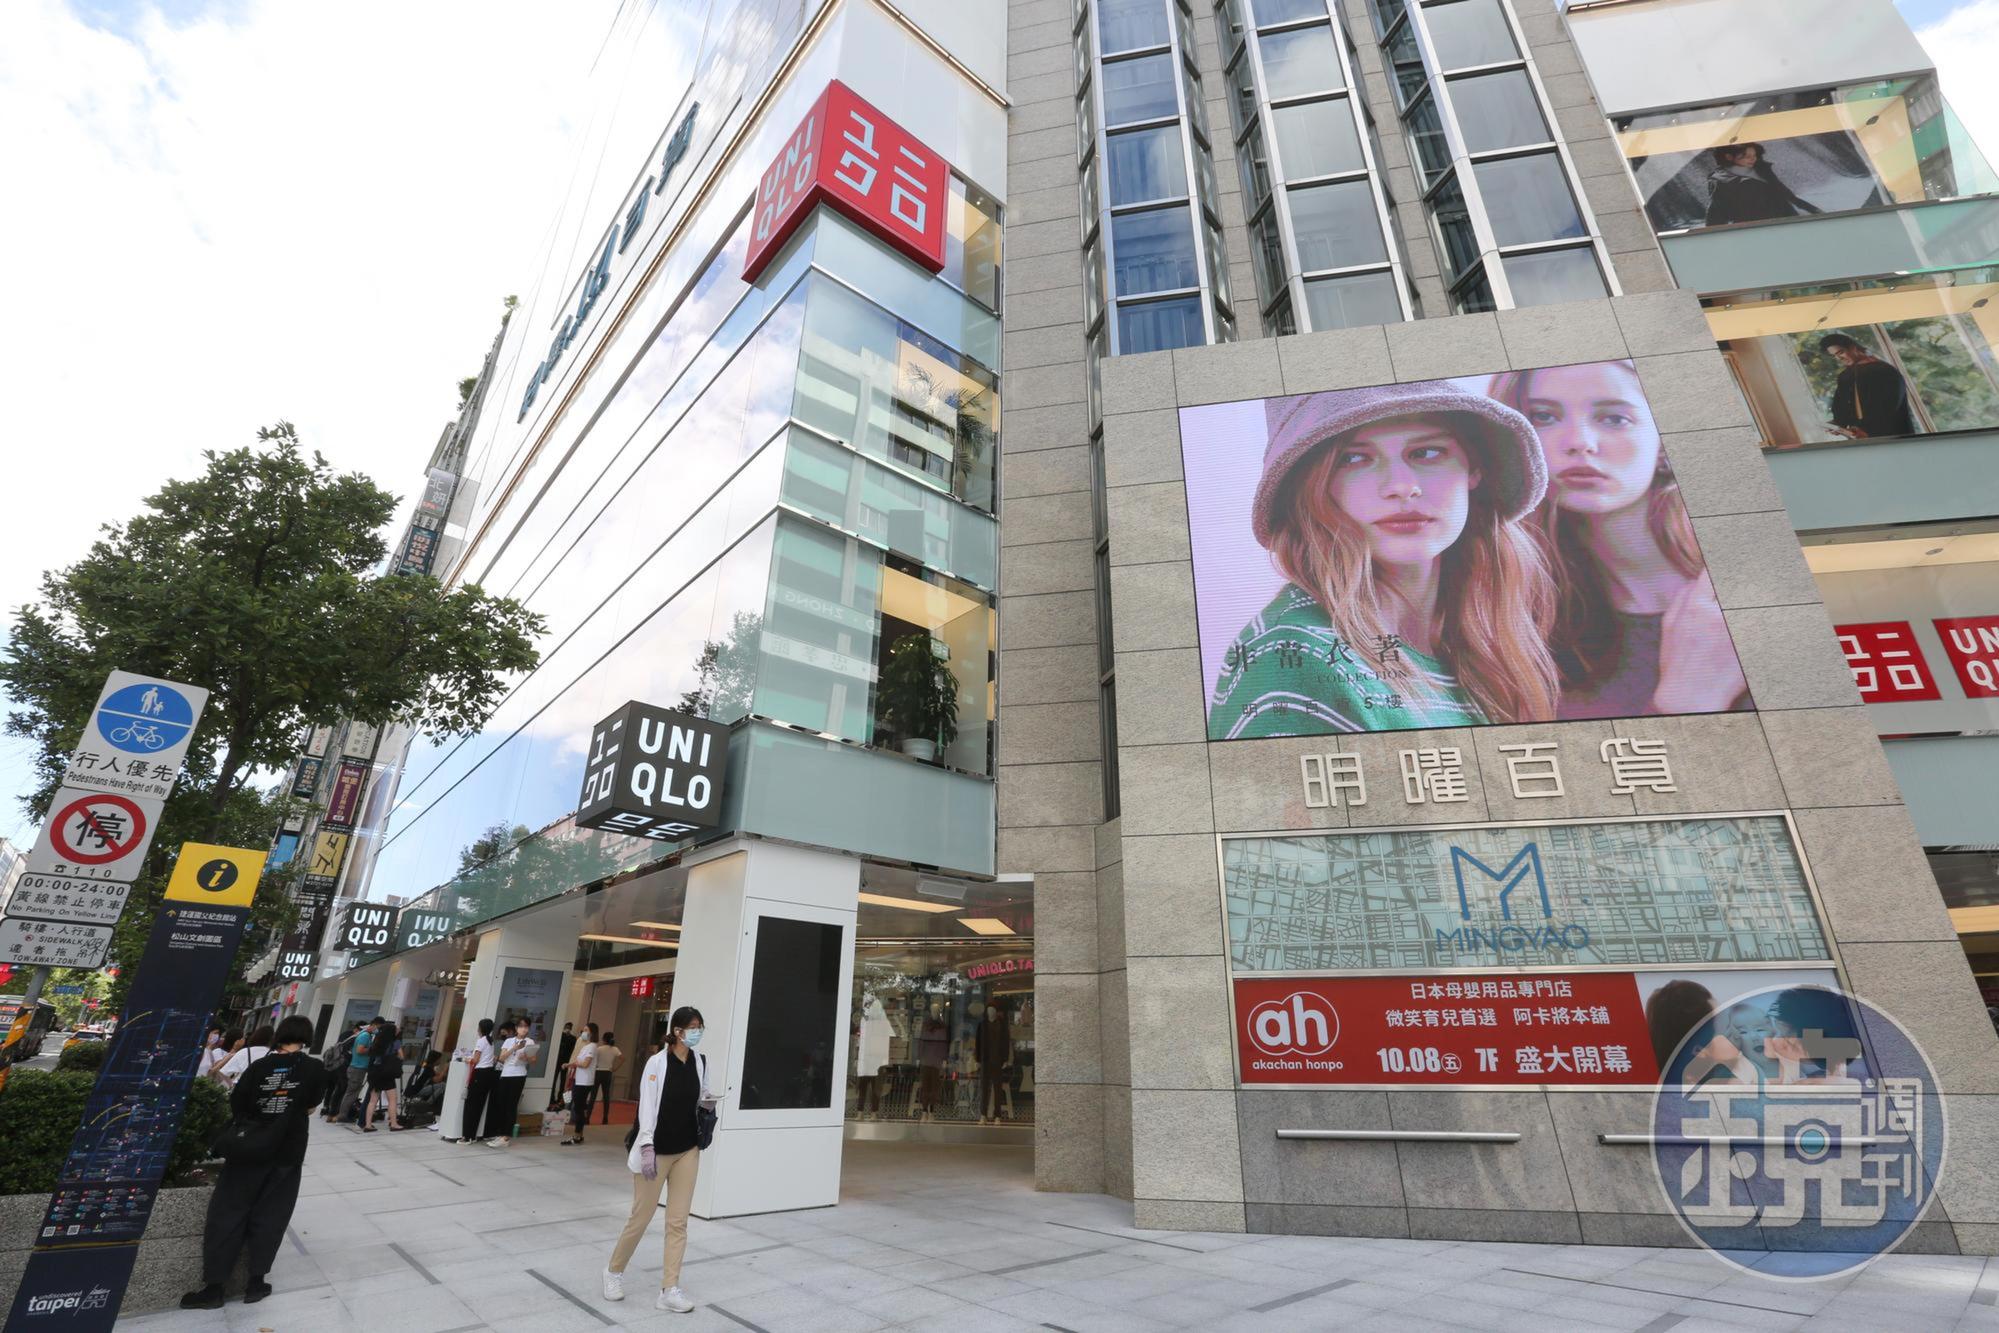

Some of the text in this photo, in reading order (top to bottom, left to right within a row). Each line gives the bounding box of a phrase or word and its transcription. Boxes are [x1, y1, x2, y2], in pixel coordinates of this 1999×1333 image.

[765, 116, 815, 201] UNI
[757, 153, 813, 241] QLO
[1966, 660, 1999, 691] Q
[638, 717, 711, 768] UNI
[76, 751, 173, 782] 行人優先
[1300, 737, 1677, 808] 明曜百貨
[67, 771, 167, 797] Pedestrians Have Right of Way
[630, 762, 711, 810] QLO
[75, 811, 127, 849] 停
[23, 877, 125, 896] 00:00-24:00
[26, 906, 55, 915] Parking
[75, 910, 97, 918] Yellow
[100, 912, 116, 920] Line
[353, 908, 390, 927] UNI
[39, 936, 82, 944] SIDEWALK
[347, 927, 389, 945] QLO
[1436, 922, 1591, 953] MINGYAO
[12, 954, 55, 963] TOW-AWAY
[285, 952, 312, 965] UNI
[281, 964, 310, 978] QLO
[1410, 980, 1573, 999] 日本母嬰用品專門店
[1255, 995, 1329, 1046] ah
[1385, 1008, 1498, 1028] 微笑育兒首選
[1252, 1058, 1344, 1072] akachan honpo
[1474, 1047, 1499, 1072] 7F
[1515, 1044, 1633, 1074] 盛大開幕
[28, 1296, 80, 1314] taipei
